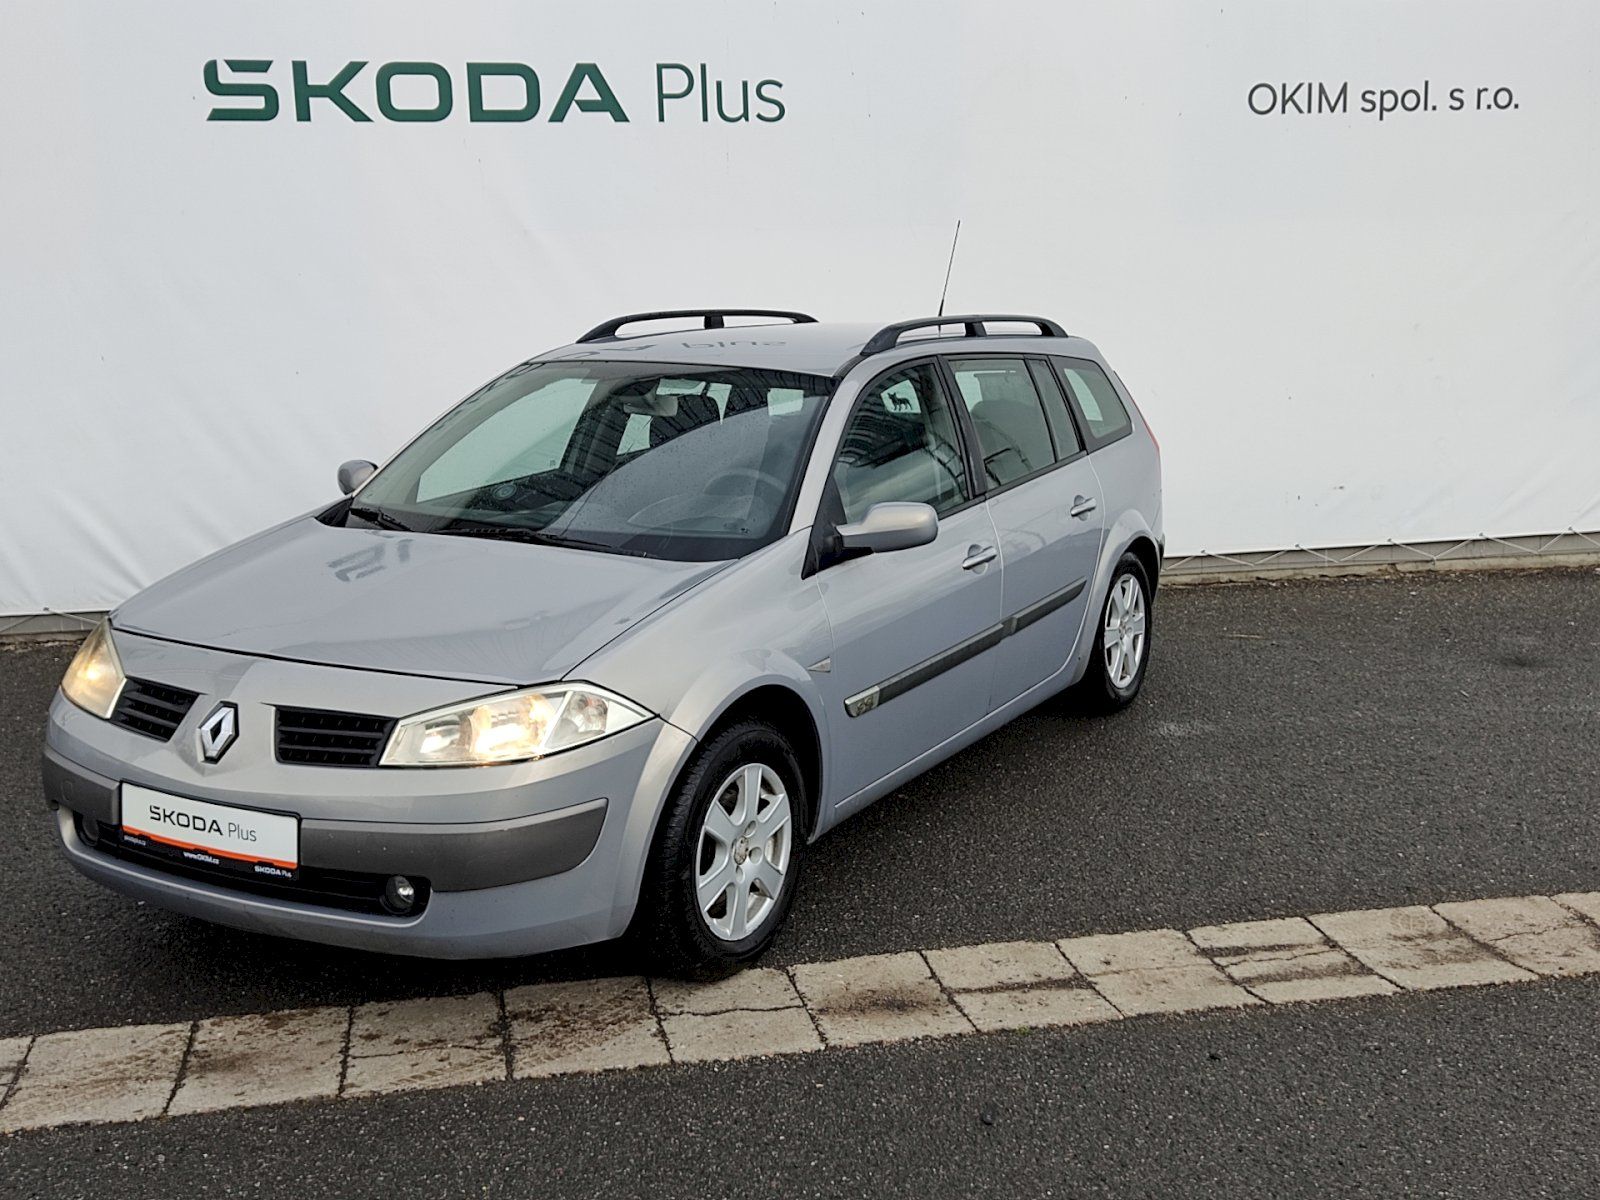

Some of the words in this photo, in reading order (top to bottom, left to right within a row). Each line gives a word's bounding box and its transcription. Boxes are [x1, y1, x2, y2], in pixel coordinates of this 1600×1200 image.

[656, 62, 786, 123] Plus
[1247, 81, 1348, 116] OKIM
[1360, 79, 1438, 122] spol.
[1448, 87, 1465, 111] s
[1476, 86, 1520, 111] r.o.
[228, 822, 257, 842] Plus
